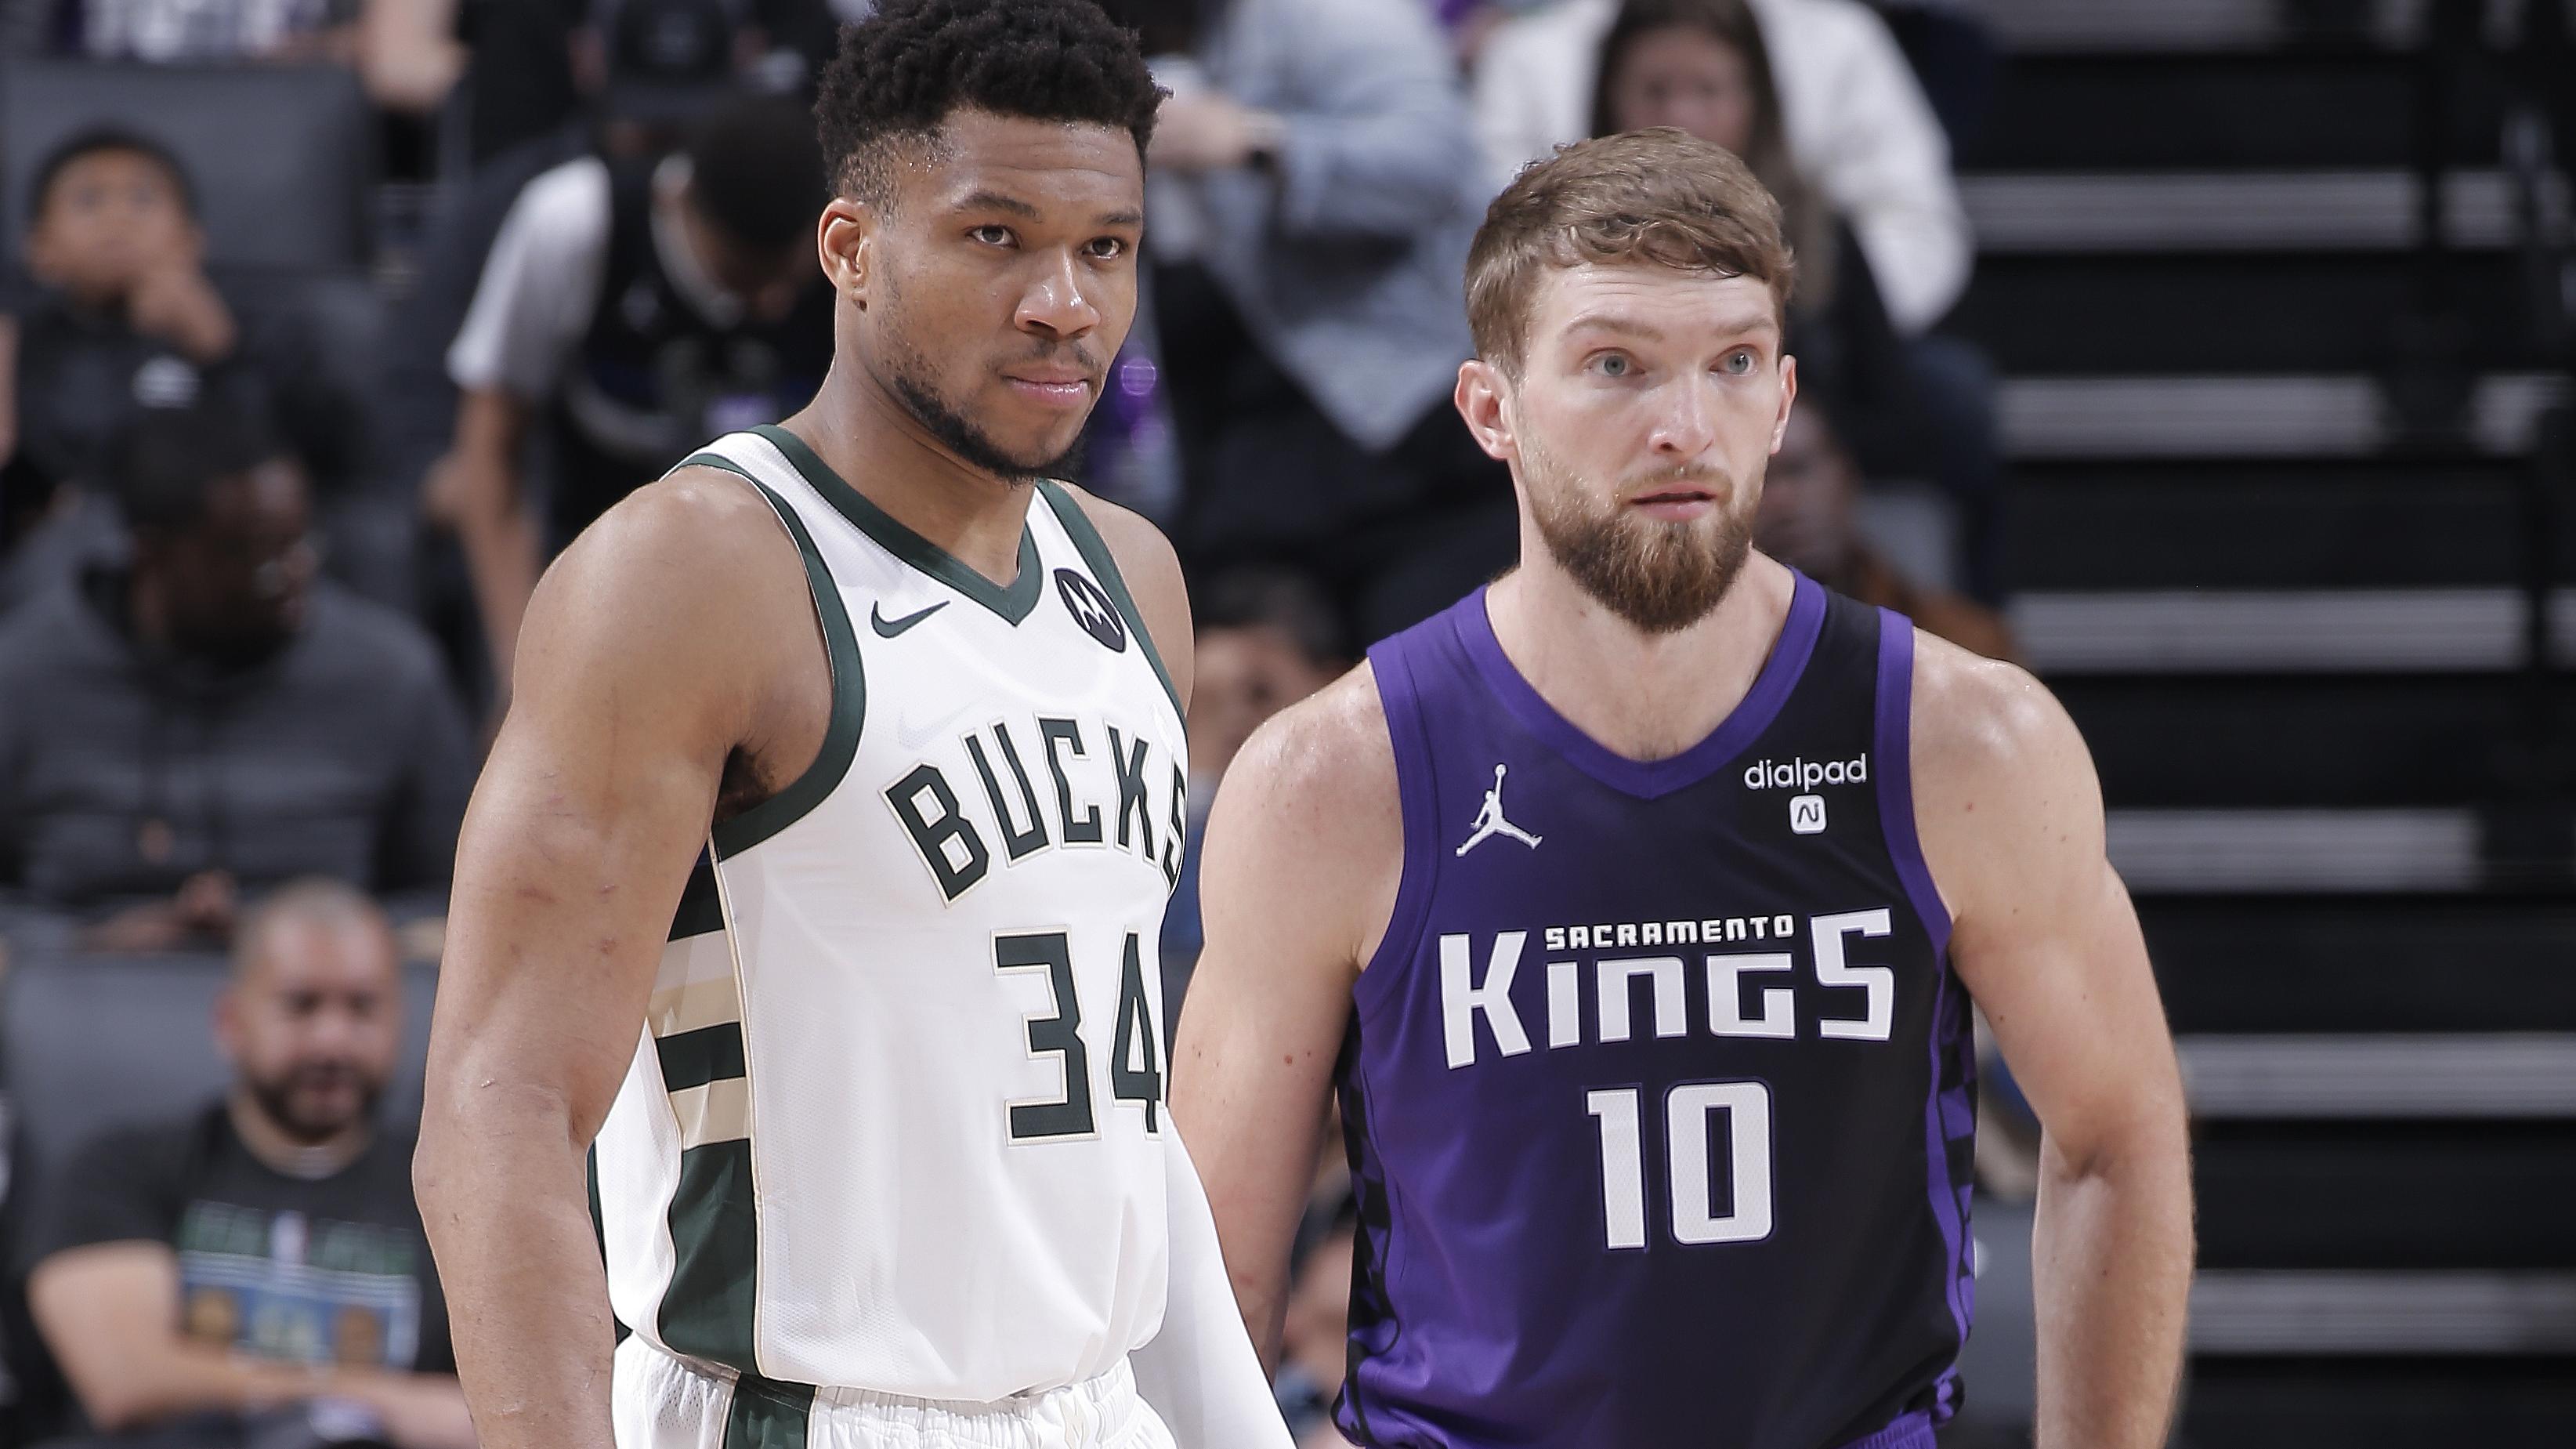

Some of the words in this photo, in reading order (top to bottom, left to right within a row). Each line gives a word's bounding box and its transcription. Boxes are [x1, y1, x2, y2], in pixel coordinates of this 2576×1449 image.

[879, 712, 1189, 907] BUCKS
[1744, 753, 1867, 792] dialpad
[1438, 908, 1894, 1070] KINGS
[1545, 915, 1794, 951] SACRAMENTO
[992, 926, 1161, 1145] 34
[1586, 1081, 1774, 1250] 10
